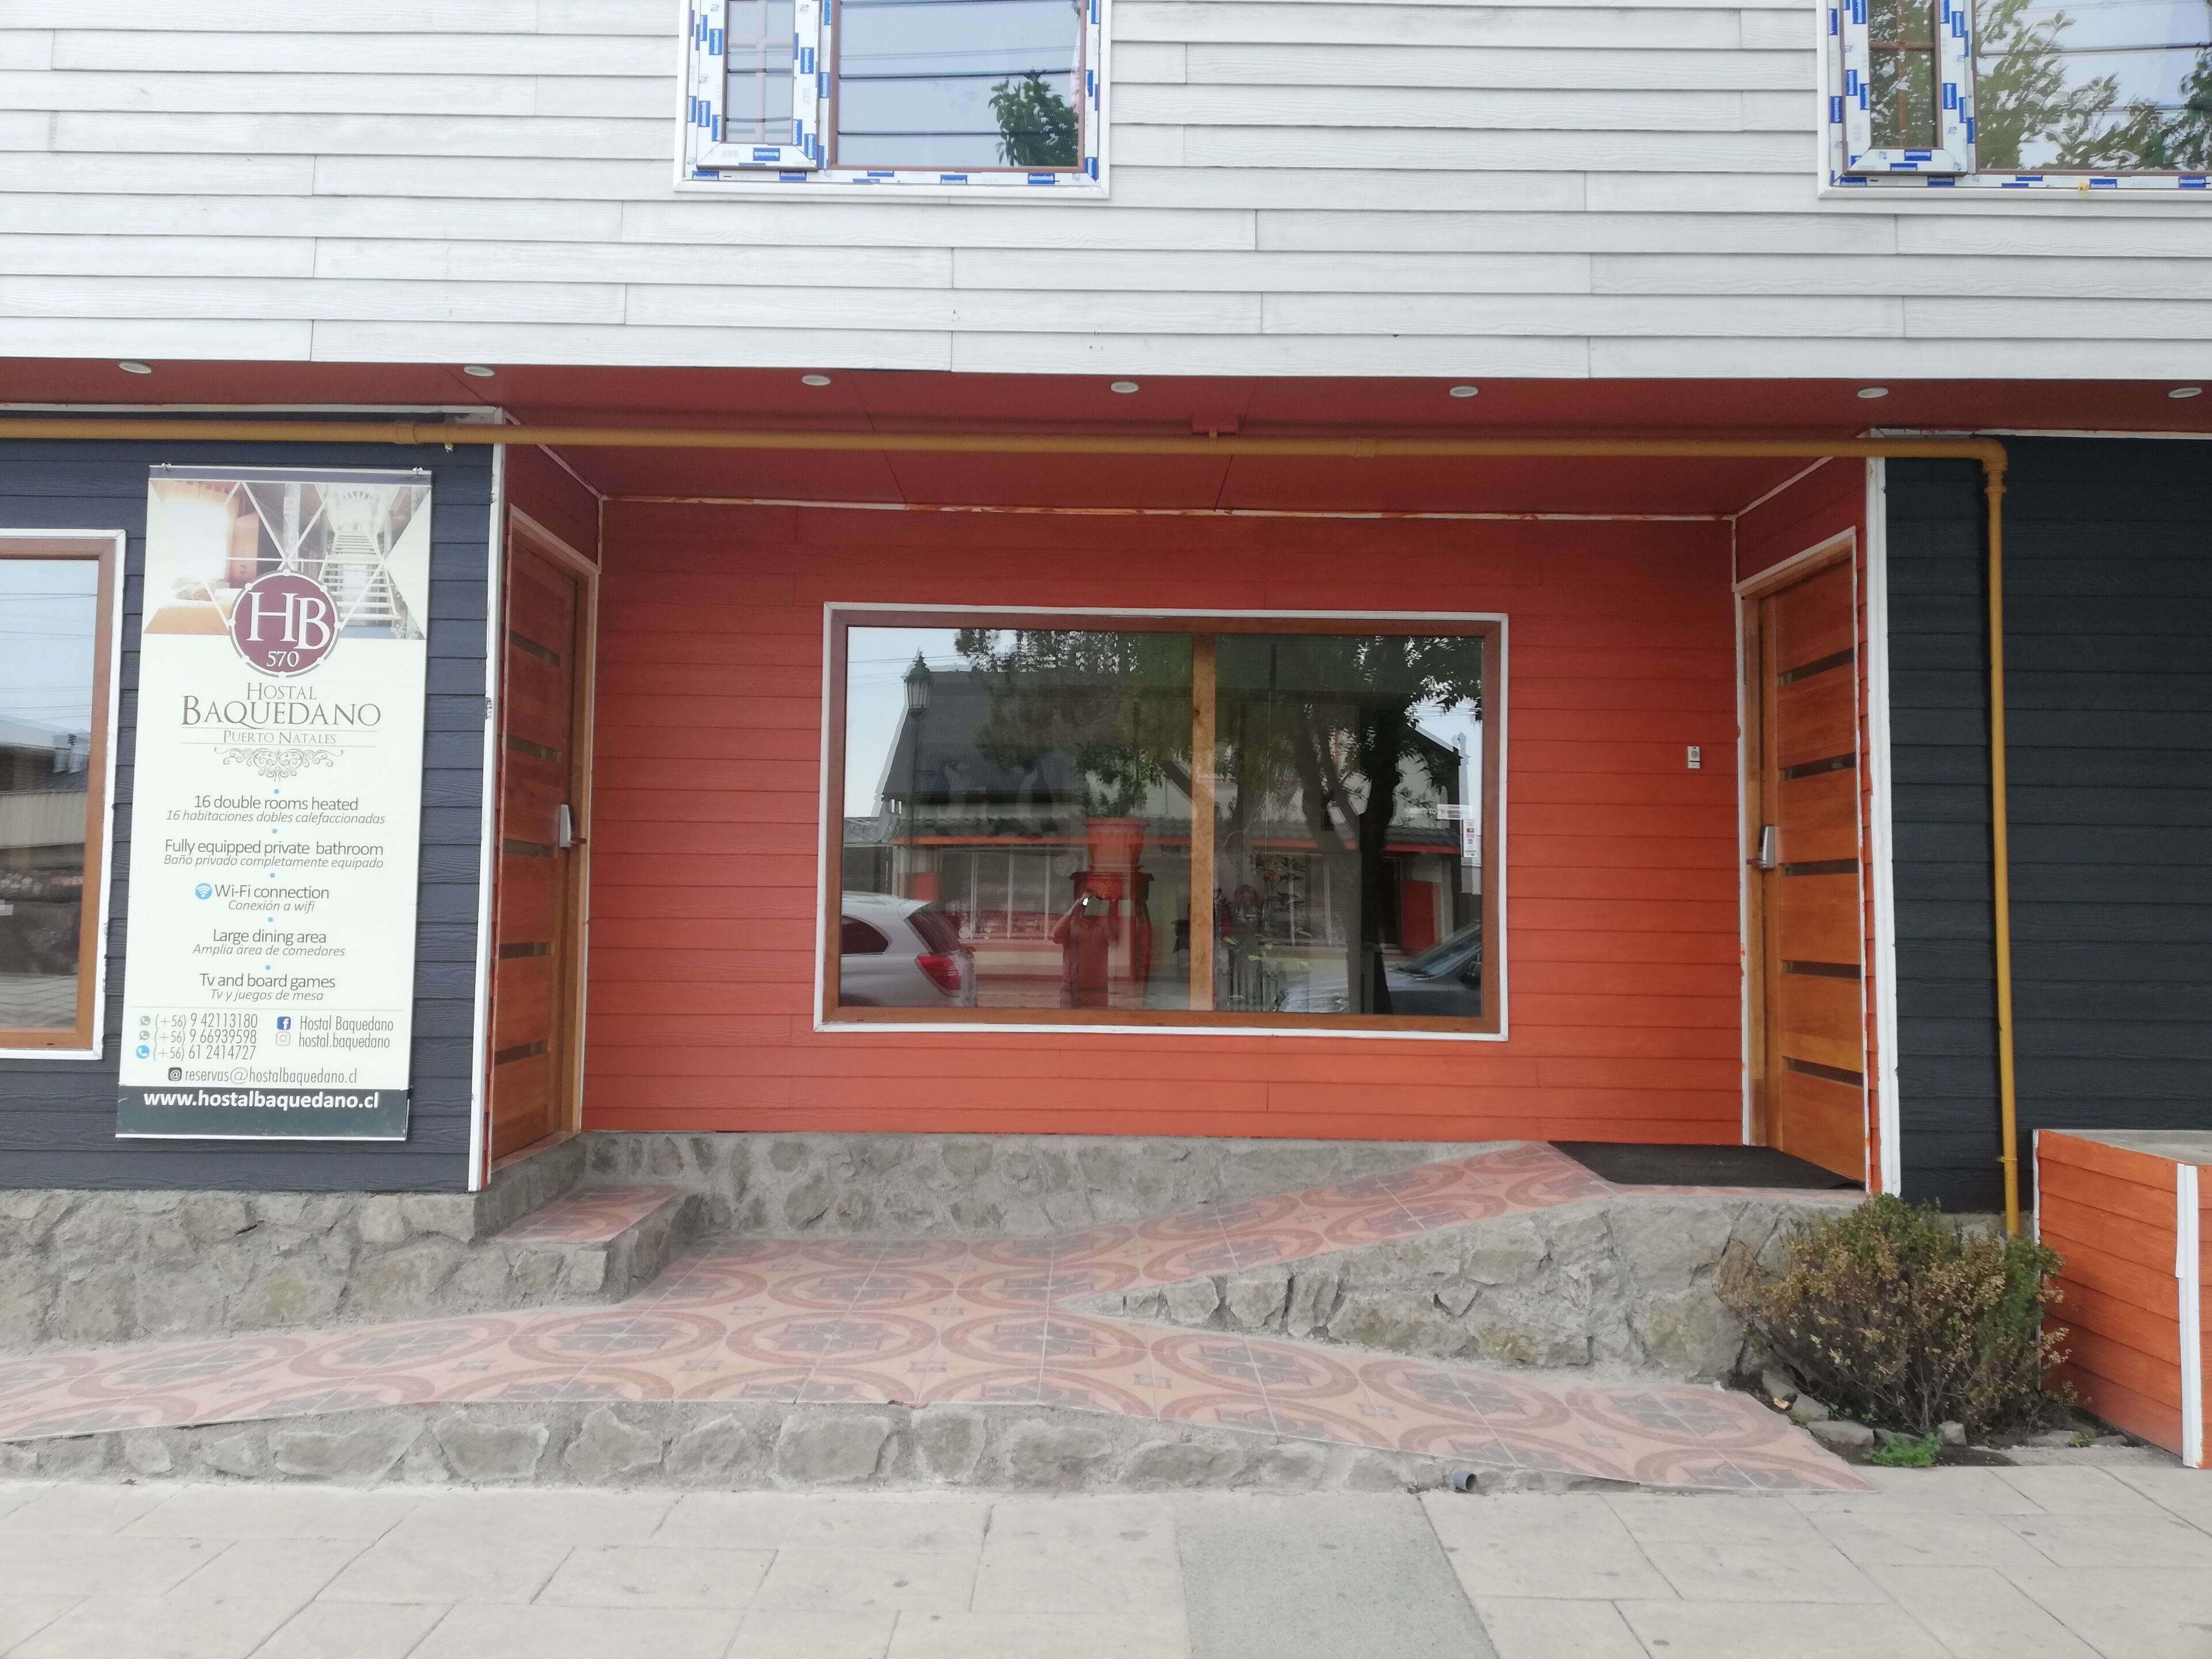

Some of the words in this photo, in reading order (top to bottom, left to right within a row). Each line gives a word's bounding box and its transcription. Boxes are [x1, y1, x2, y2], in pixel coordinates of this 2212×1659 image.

[245, 591, 331, 651] HB
[266, 650, 300, 668] 570
[246, 682, 317, 700] HOSTAL
[181, 695, 381, 730] BAQUEDANO
[224, 730, 274, 743] PUERTO
[279, 731, 336, 744] NATALES
[194, 795, 211, 808] 16
[214, 794, 262, 809] double
[264, 799, 308, 810] rooms
[311, 796, 358, 811] heated
[166, 809, 181, 820] 16
[182, 809, 254, 822] habitaciones
[256, 810, 294, 823] dobles
[295, 812, 386, 825] calefaccionadas
[165, 838, 196, 857] Fully
[198, 839, 262, 857] equipped
[264, 840, 310, 857] private
[316, 840, 384, 856] bathroom
[164, 854, 193, 865] Baño
[194, 854, 238, 868] privado
[240, 855, 329, 869] completamente
[331, 857, 384, 870] equipado
[214, 884, 251, 898] Wi-Fi
[253, 885, 329, 899] connection
[228, 900, 281, 911] Conexión
[283, 903, 291, 911] a
[294, 900, 316, 914] wifi
[213, 929, 249, 947] Large
[252, 928, 295, 946] dining
[297, 933, 327, 944] area
[192, 944, 234, 957] Amplia
[236, 944, 263, 955] área
[265, 944, 280, 956] de
[282, 945, 346, 956] comedores
[199, 973, 218, 986] Tv
[217, 972, 244, 987] and
[247, 972, 287, 988] board
[290, 978, 336, 991] games
[211, 988, 224, 999] Tv
[225, 991, 233, 1002] y
[232, 989, 273, 1002] juegos
[275, 989, 290, 1001] de
[292, 992, 324, 1001] mesa
[155, 1014, 187, 1031] (+56)
[190, 1012, 198, 1028] 9
[200, 1013, 258, 1029] 42113180
[300, 1014, 332, 1031] Hostal
[335, 1015, 393, 1035] Baquedano
[154, 1029, 185, 1046] (+56)
[190, 1028, 196, 1043] 9
[199, 1028, 257, 1044] 66939598
[298, 1031, 390, 1051] hostal.baquedano
[153, 1044, 185, 1062] (+56)
[188, 1044, 201, 1059] 61
[206, 1044, 256, 1060] 2414727
[185, 1066, 357, 1086] reservas@hostalbaquedano.cl
[143, 1088, 380, 1111] www.hostalbaquedano.cl
